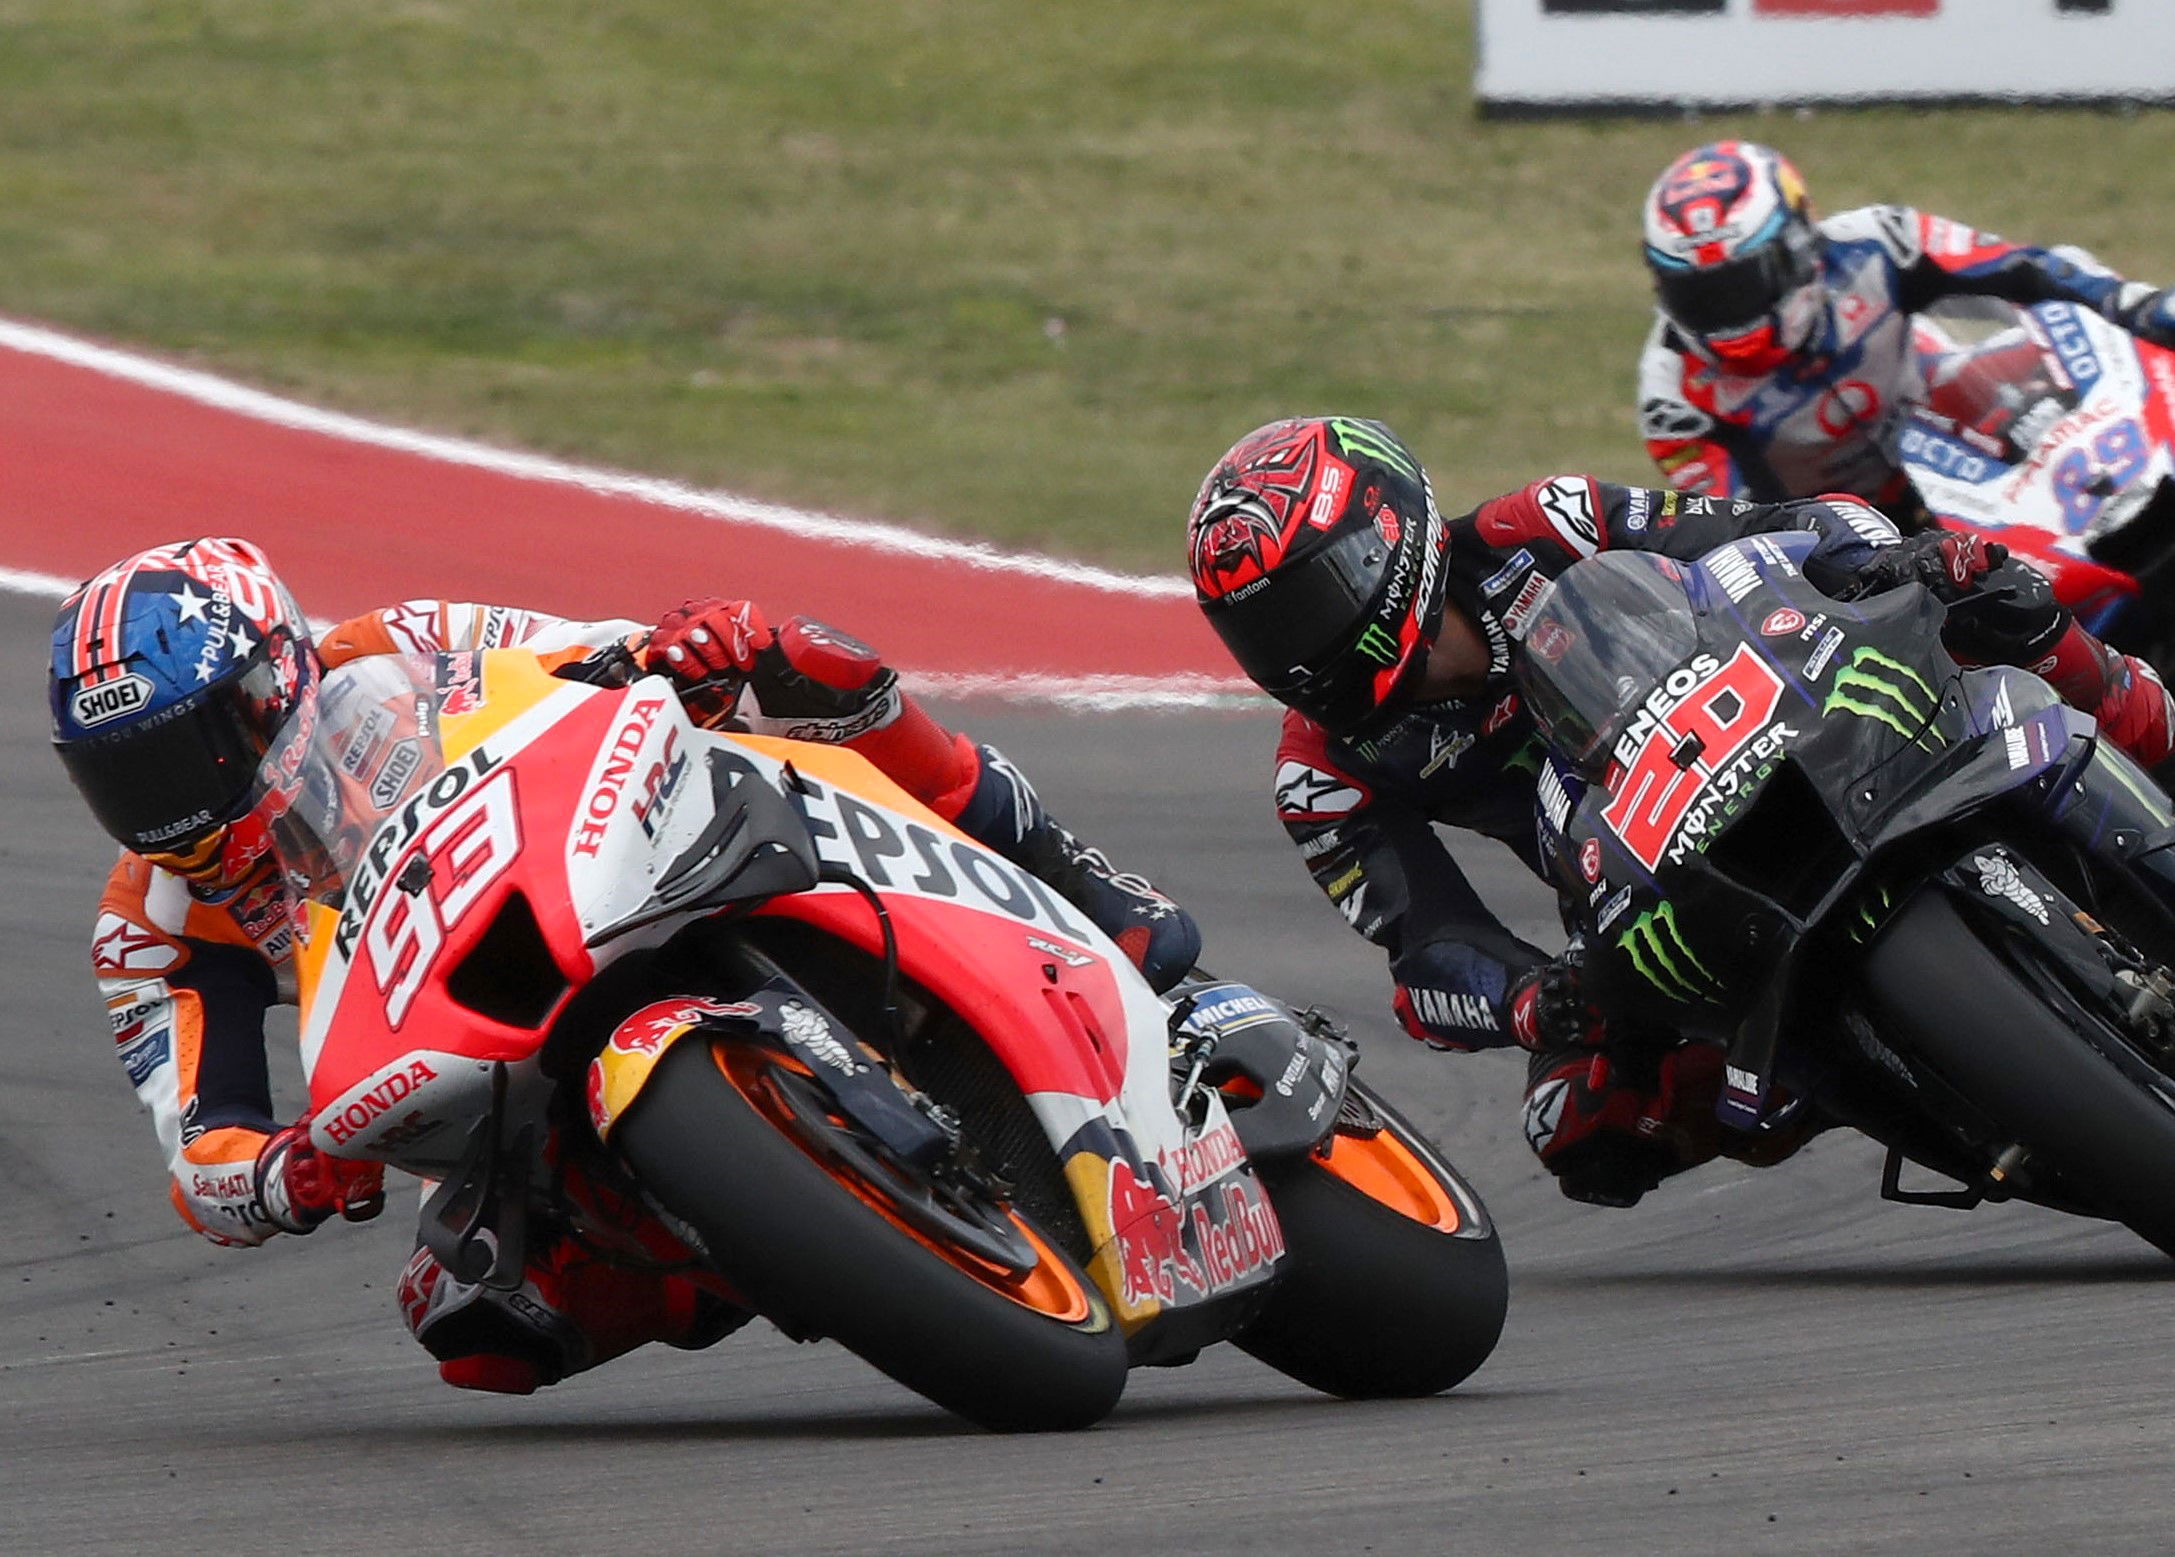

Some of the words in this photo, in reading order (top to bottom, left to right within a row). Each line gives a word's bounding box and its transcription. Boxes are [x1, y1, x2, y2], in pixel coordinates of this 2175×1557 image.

[2052, 418, 2150, 537] 89
[200, 565, 232, 662] PULL&BEAR
[1231, 576, 1271, 603] fantom
[1380, 517, 1417, 620] MONSTER
[1509, 575, 1547, 620] YAMAHA
[1480, 609, 1511, 674] YAMAHA
[1800, 612, 1827, 642] msi
[79, 681, 142, 720] SHOEI
[1613, 653, 1720, 769] ENEOS
[376, 746, 417, 803] SHOEI
[573, 699, 666, 859] HONDA
[631, 723, 687, 841] HRC
[1667, 721, 1800, 866] MONSTER
[1696, 749, 1788, 855] ENERGY
[334, 745, 503, 965] REPSOL
[365, 764, 526, 1031] 93
[1408, 986, 1500, 1033] YAMAHA
[323, 1060, 438, 1146] HONDA
[1171, 1123, 1247, 1187] HONDA
